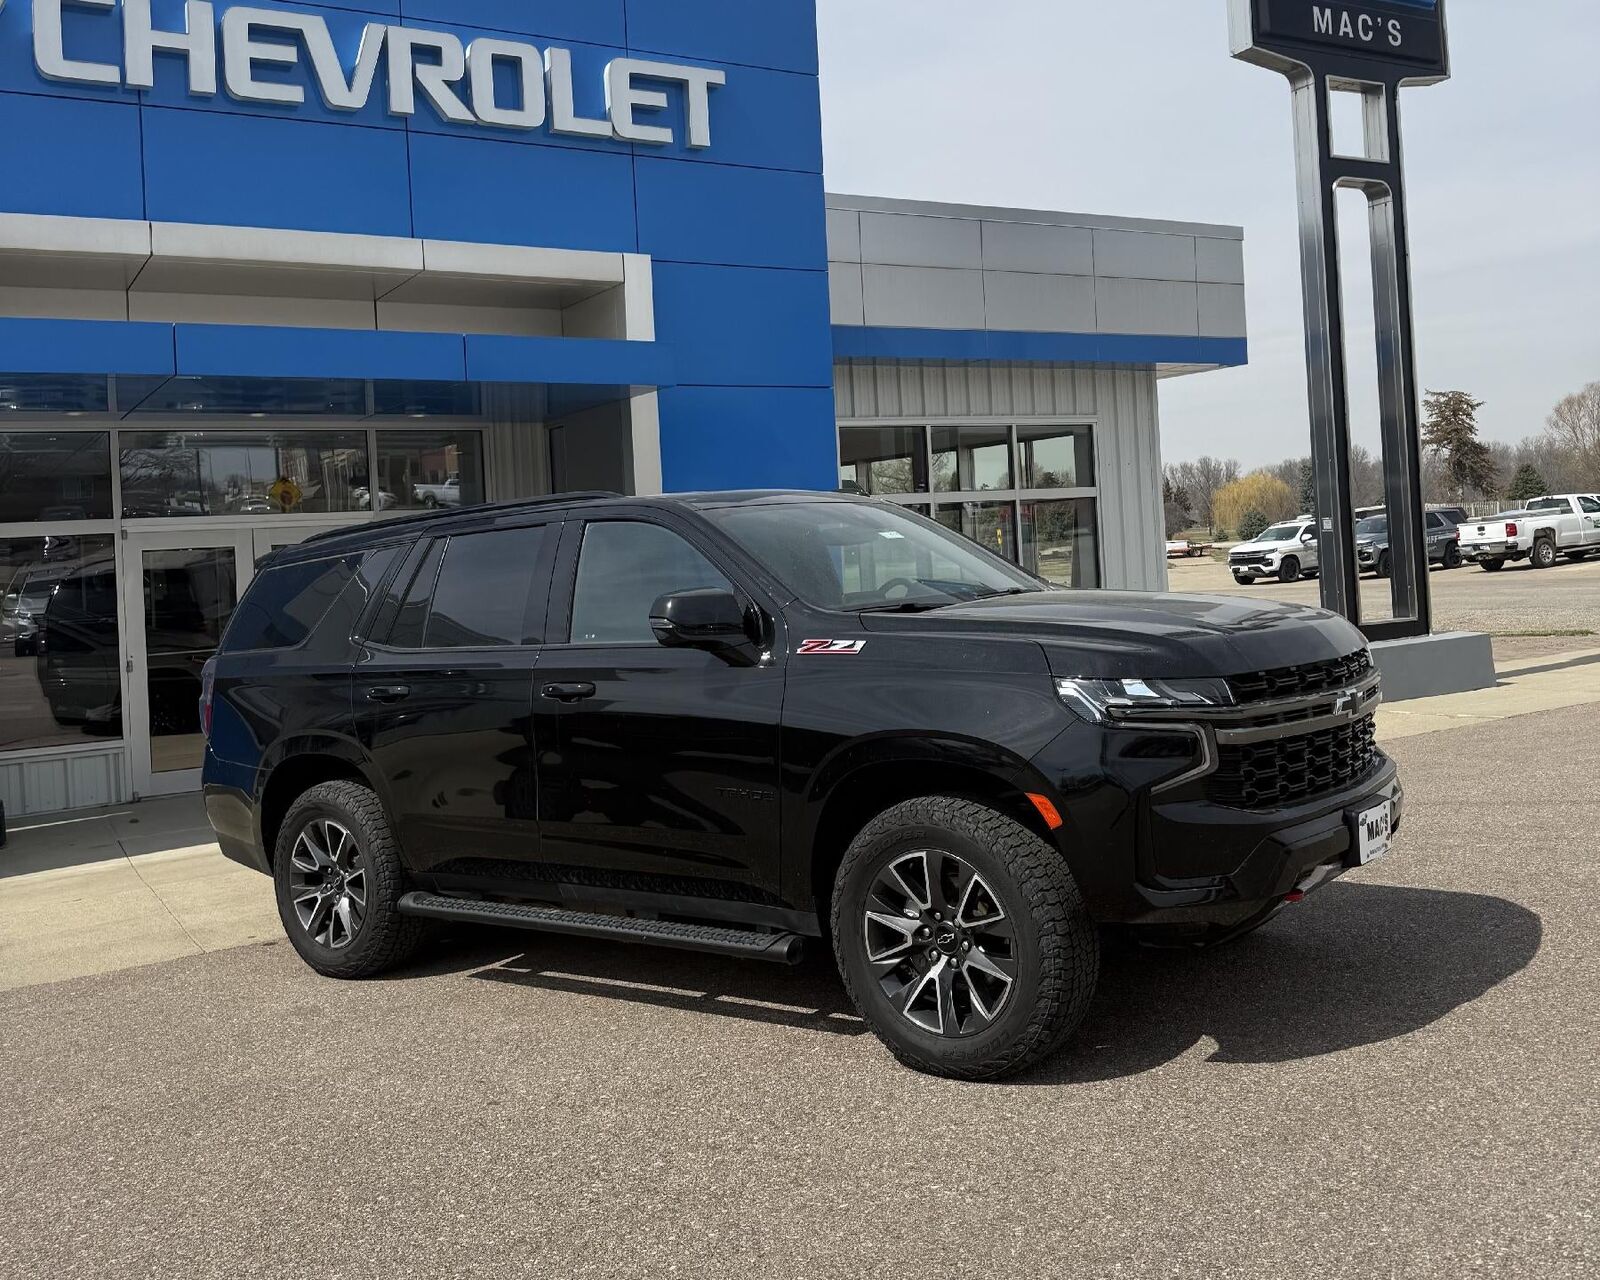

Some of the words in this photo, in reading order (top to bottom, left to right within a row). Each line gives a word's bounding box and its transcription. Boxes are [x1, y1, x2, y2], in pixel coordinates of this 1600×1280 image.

[1312, 5, 1402, 47] MAC'S
[32, 0, 726, 150] CHEVROLET
[796, 639, 867, 654] Z71
